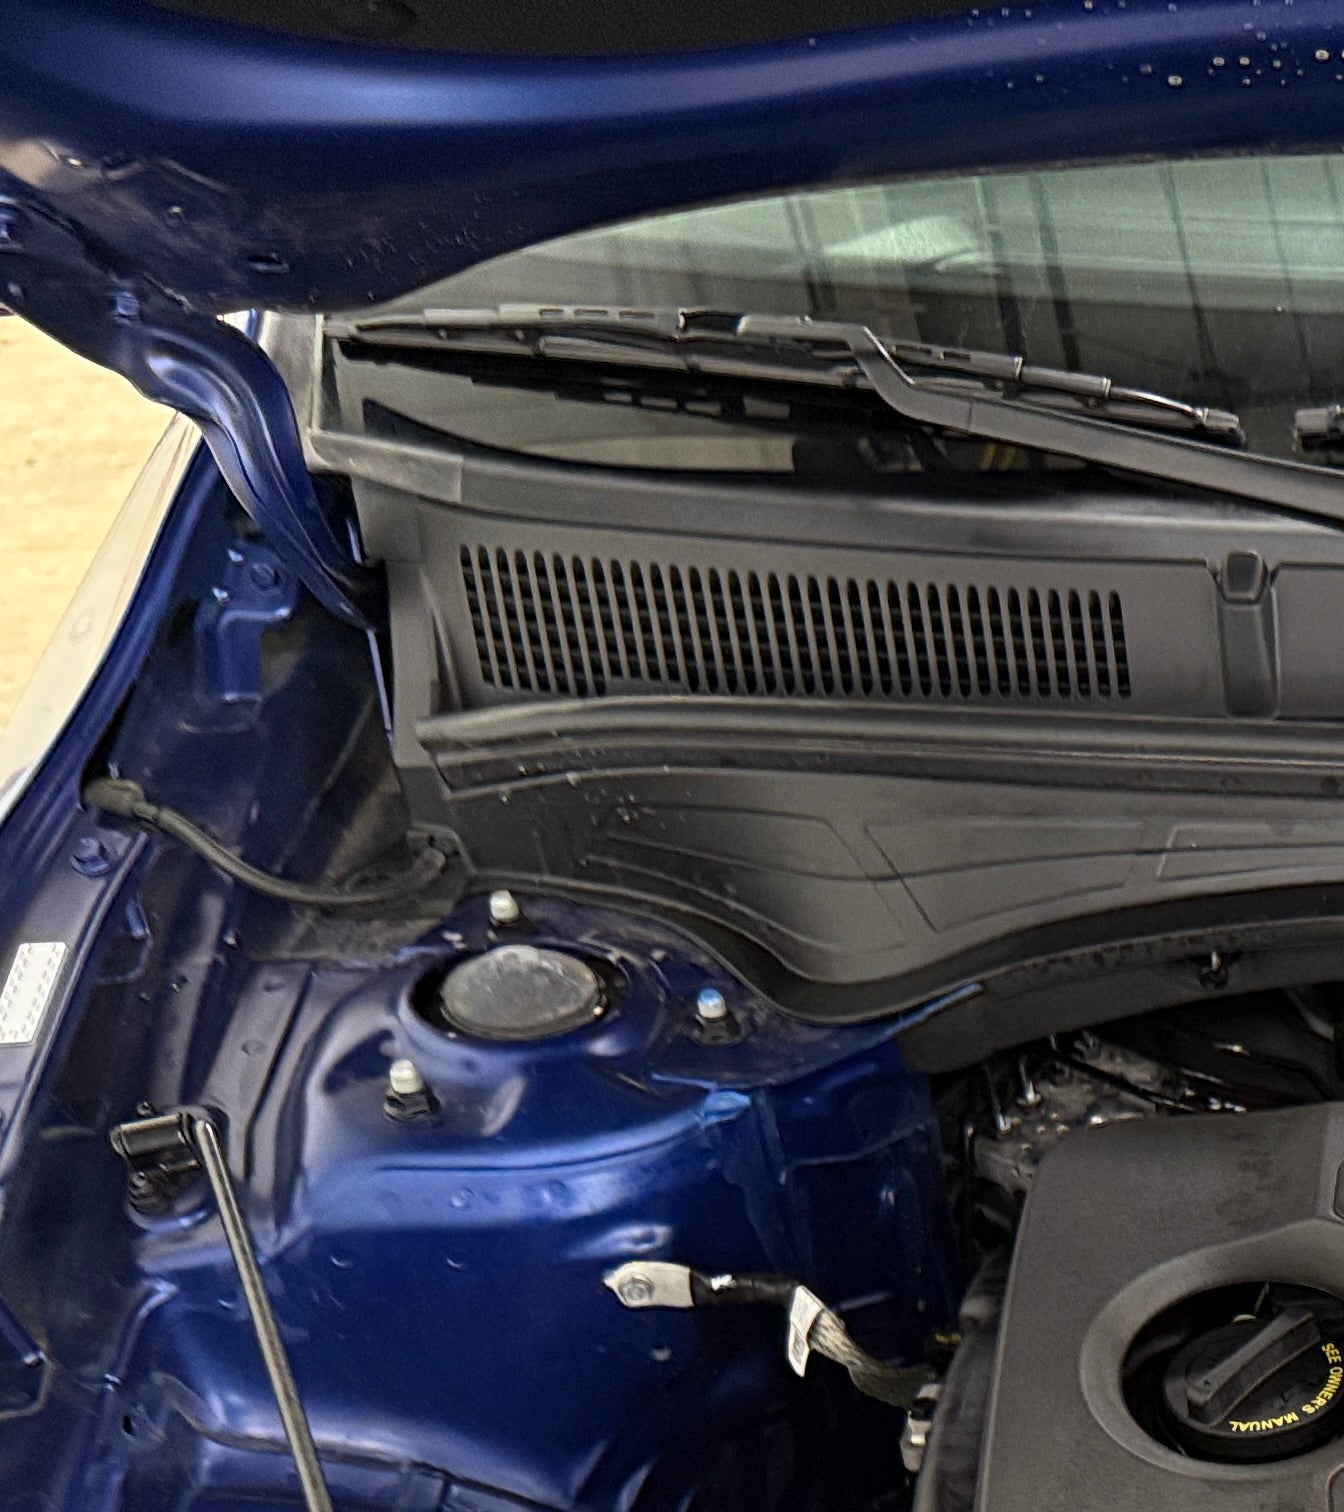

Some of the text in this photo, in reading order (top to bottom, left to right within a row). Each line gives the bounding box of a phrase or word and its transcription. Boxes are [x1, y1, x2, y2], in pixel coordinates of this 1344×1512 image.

[1229, 1342, 1344, 1432] SEE OWNER'S MANUAL
